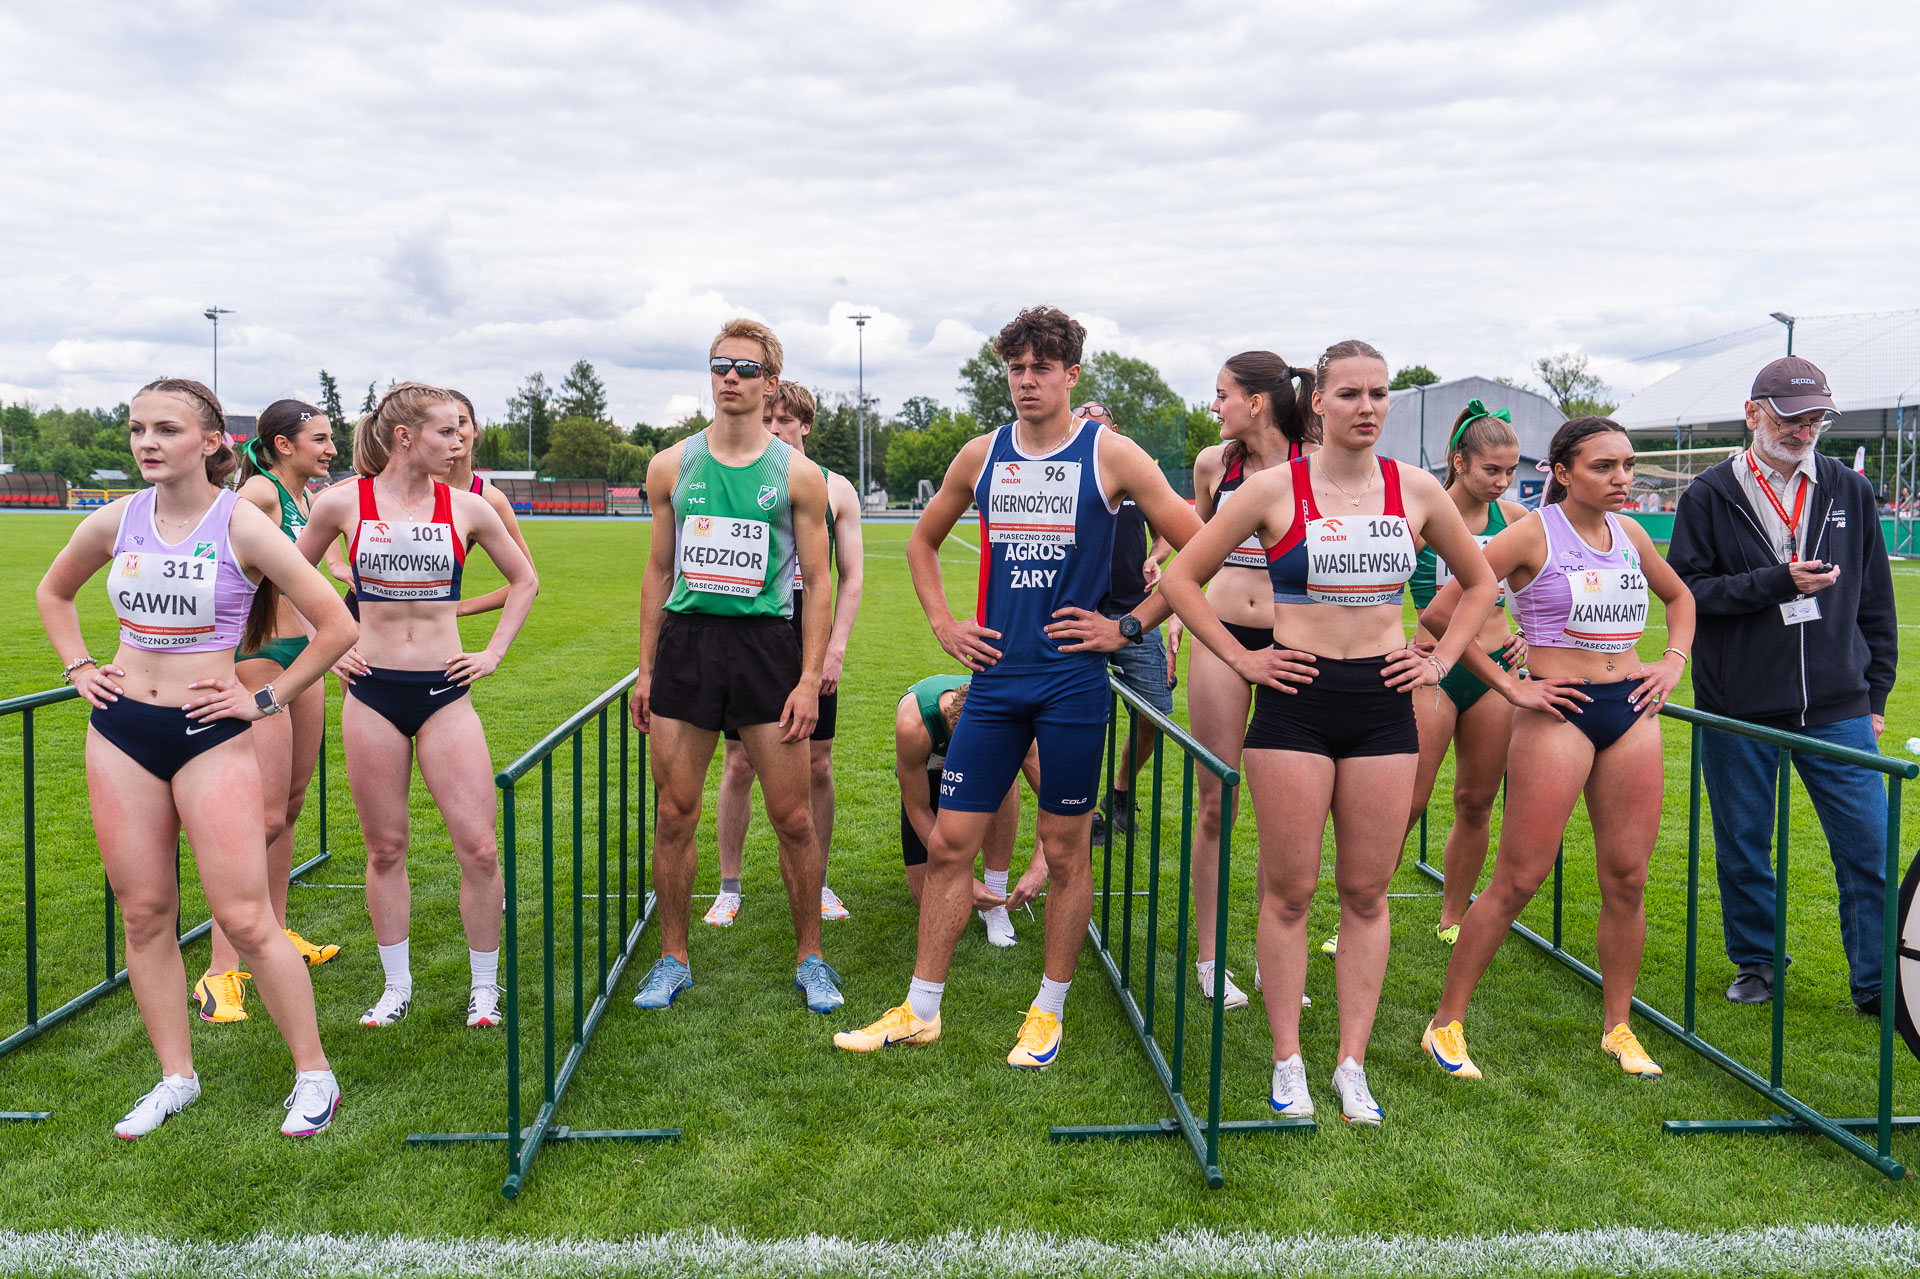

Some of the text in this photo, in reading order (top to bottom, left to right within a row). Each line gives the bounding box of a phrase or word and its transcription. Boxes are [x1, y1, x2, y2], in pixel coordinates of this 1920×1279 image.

[1044, 465, 1066, 482] 96
[991, 490, 1073, 514] KIERNOŻYCKI
[411, 526, 444, 542] 101
[730, 522, 763, 540] 313
[999, 533, 1061, 542] PIASECZNO 2026
[1368, 520, 1403, 538] 106
[682, 545, 763, 570] KĘDZIOR
[1004, 543, 1066, 561] AGROS
[1227, 554, 1266, 564] PIASECZNO
[162, 560, 205, 580] 311
[359, 552, 450, 574] PIĄTKOWSKA
[1312, 552, 1412, 574] WASILEWSKA
[1010, 565, 1058, 589] ŻARY
[1619, 573, 1645, 590] 312
[372, 586, 439, 597] PIASECZNO 2026
[688, 581, 751, 594] PIASECZNO 2026
[118, 590, 197, 616] GAWIN
[1321, 594, 1376, 603] PIASECZNO
[1572, 603, 1646, 623] KANAKANTI
[129, 631, 197, 645] PIASECZNO 2026
[1574, 640, 1622, 651] PIASECZNO
[1060, 797, 1088, 805] COLO
